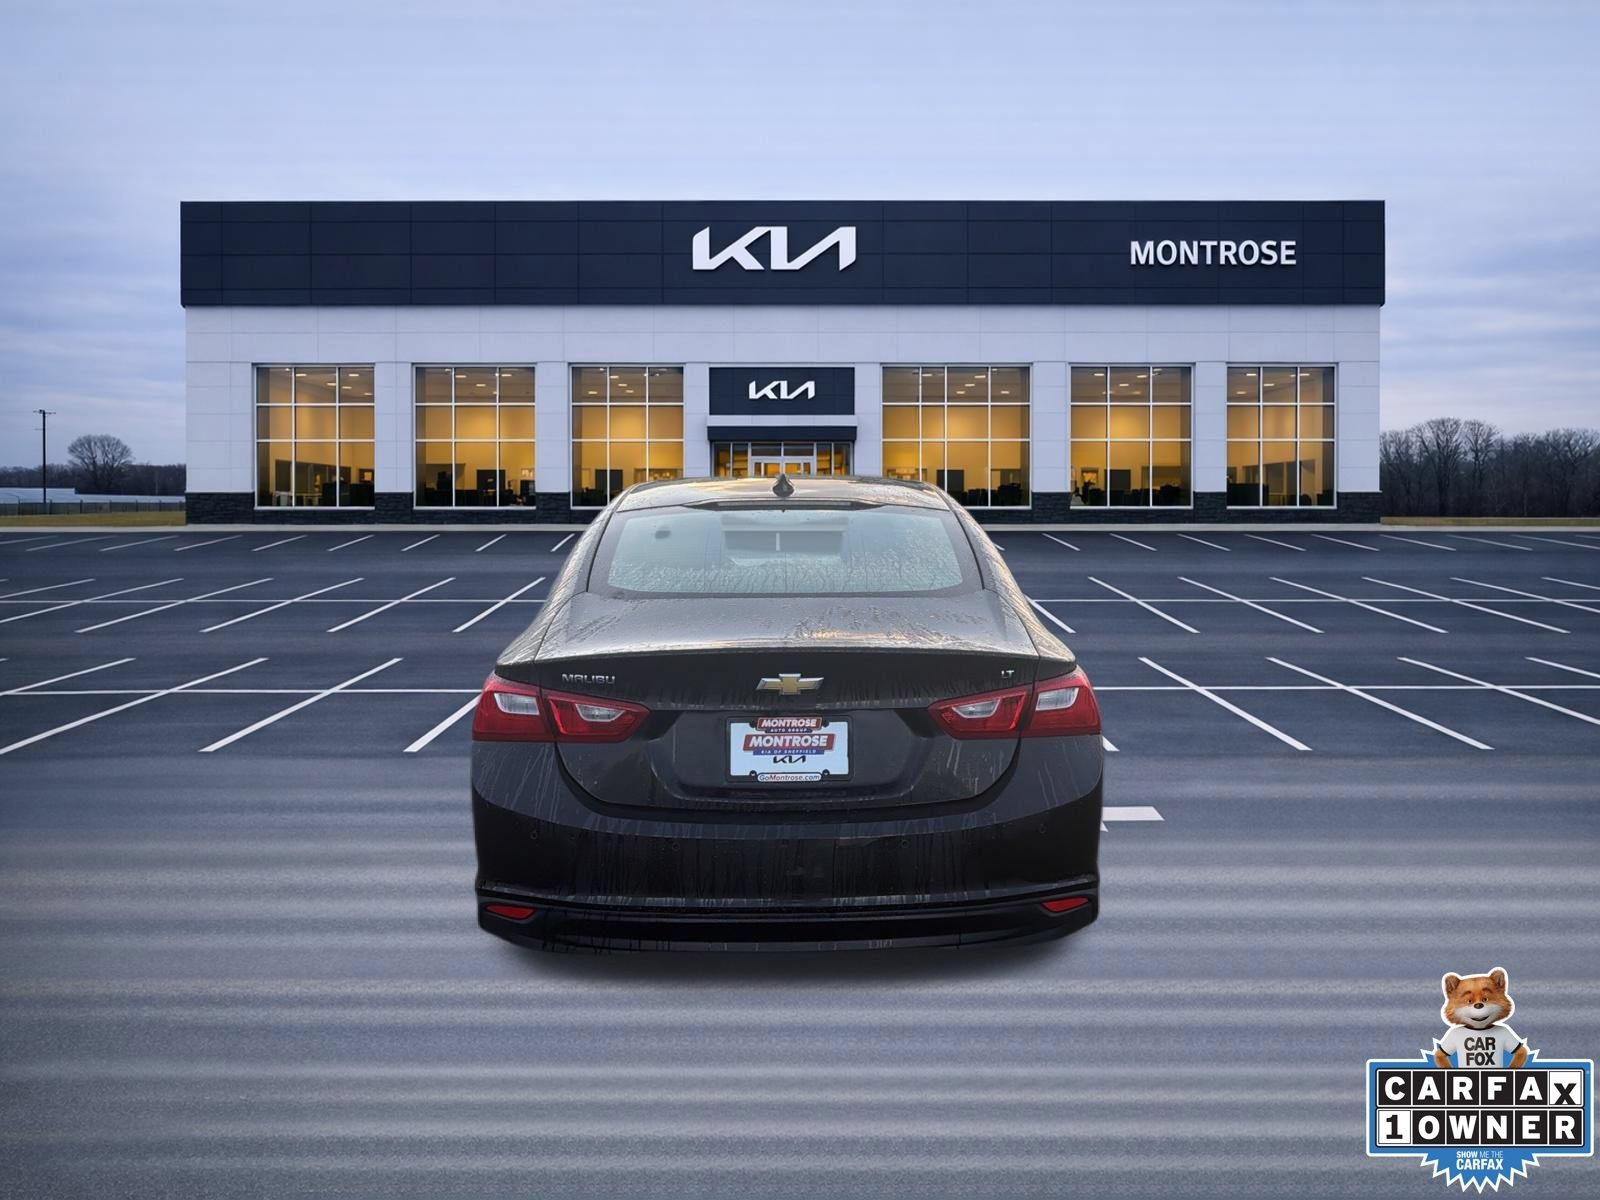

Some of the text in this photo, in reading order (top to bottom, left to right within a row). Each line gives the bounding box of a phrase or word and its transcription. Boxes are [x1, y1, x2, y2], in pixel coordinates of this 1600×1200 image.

[692, 226, 857, 271] KIA
[1130, 239, 1297, 266] MONTROSE
[748, 380, 816, 400] KIA
[561, 673, 616, 685] MALIBU
[1001, 669, 1015, 679] LT
[761, 718, 818, 728] MONTROSE
[749, 735, 829, 748] MONTROSE
[759, 774, 820, 782] GoMontrose.com
